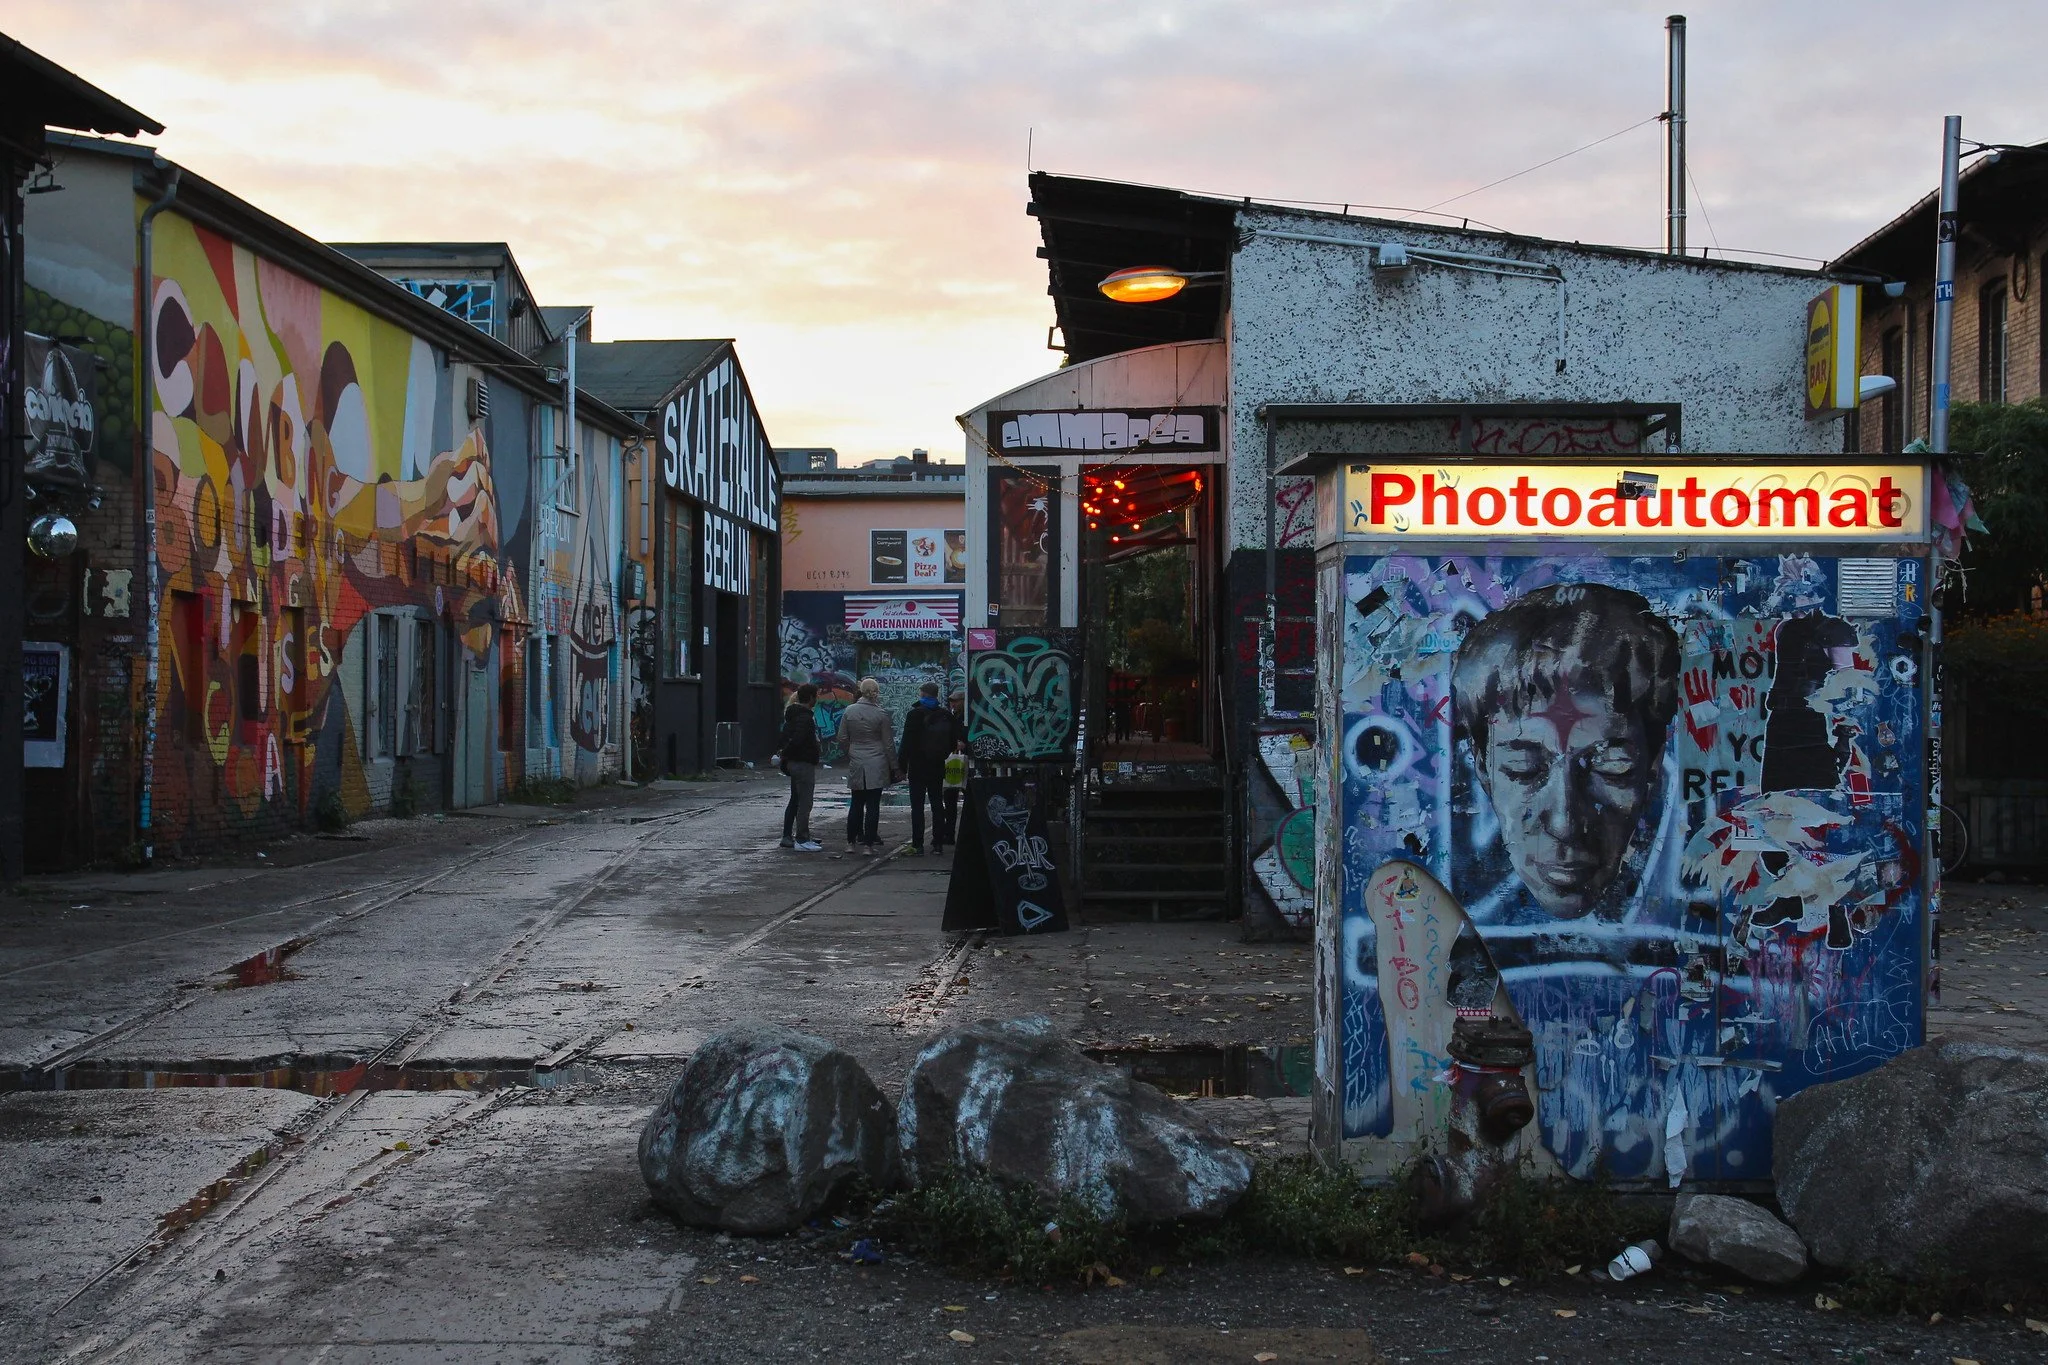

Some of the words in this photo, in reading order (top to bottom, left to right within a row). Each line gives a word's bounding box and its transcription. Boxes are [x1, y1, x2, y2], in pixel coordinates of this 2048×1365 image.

[1810, 358, 1827, 389] BAR
[664, 357, 777, 533] SKATEHALLE
[1370, 472, 1903, 528] Photoautomat
[703, 510, 749, 596] BERLIN
[914, 562, 937, 571] Pizza
[861, 618, 943, 629] WARENANNAHME
[991, 835, 1056, 873] BAR
